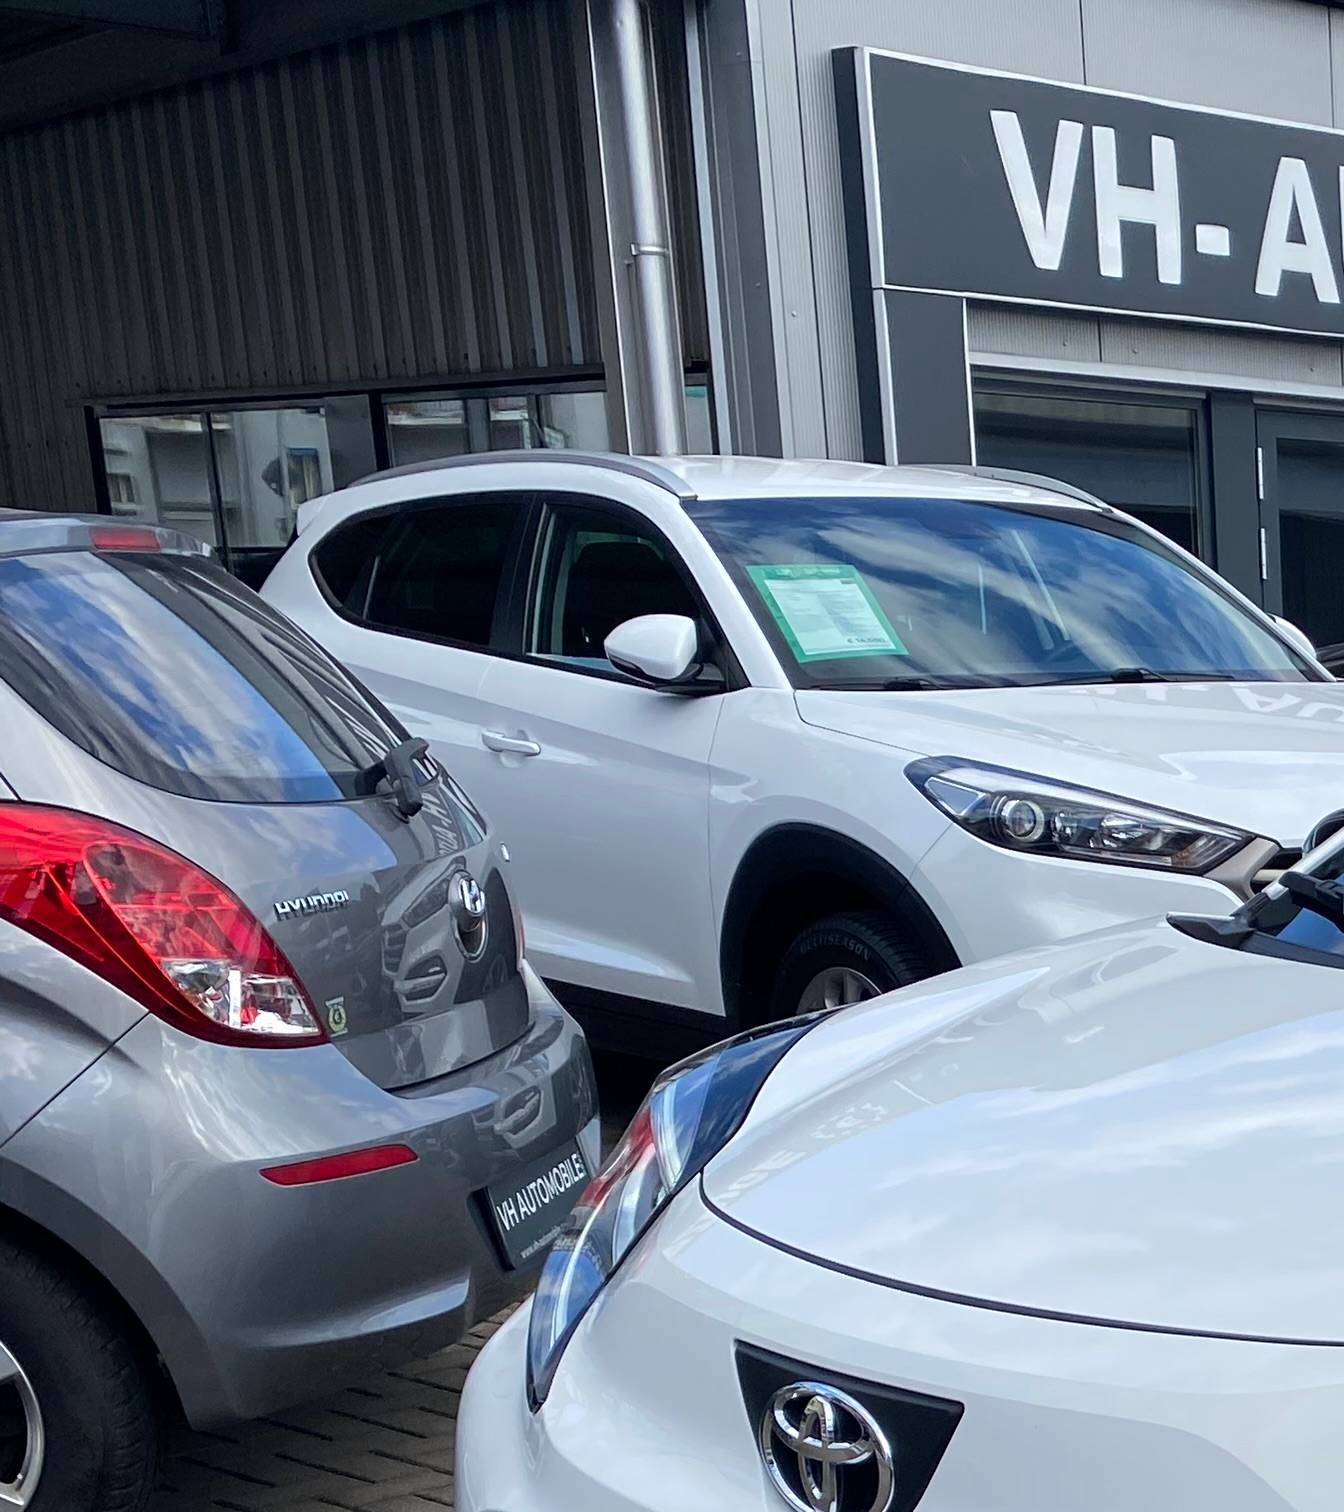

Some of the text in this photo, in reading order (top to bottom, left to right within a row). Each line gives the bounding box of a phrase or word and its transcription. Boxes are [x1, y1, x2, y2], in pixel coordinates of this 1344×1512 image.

[273, 889, 350, 919] HYUNDAI
[496, 1197, 520, 1231] VH
[515, 1152, 585, 1221] AUTOMOBILE
